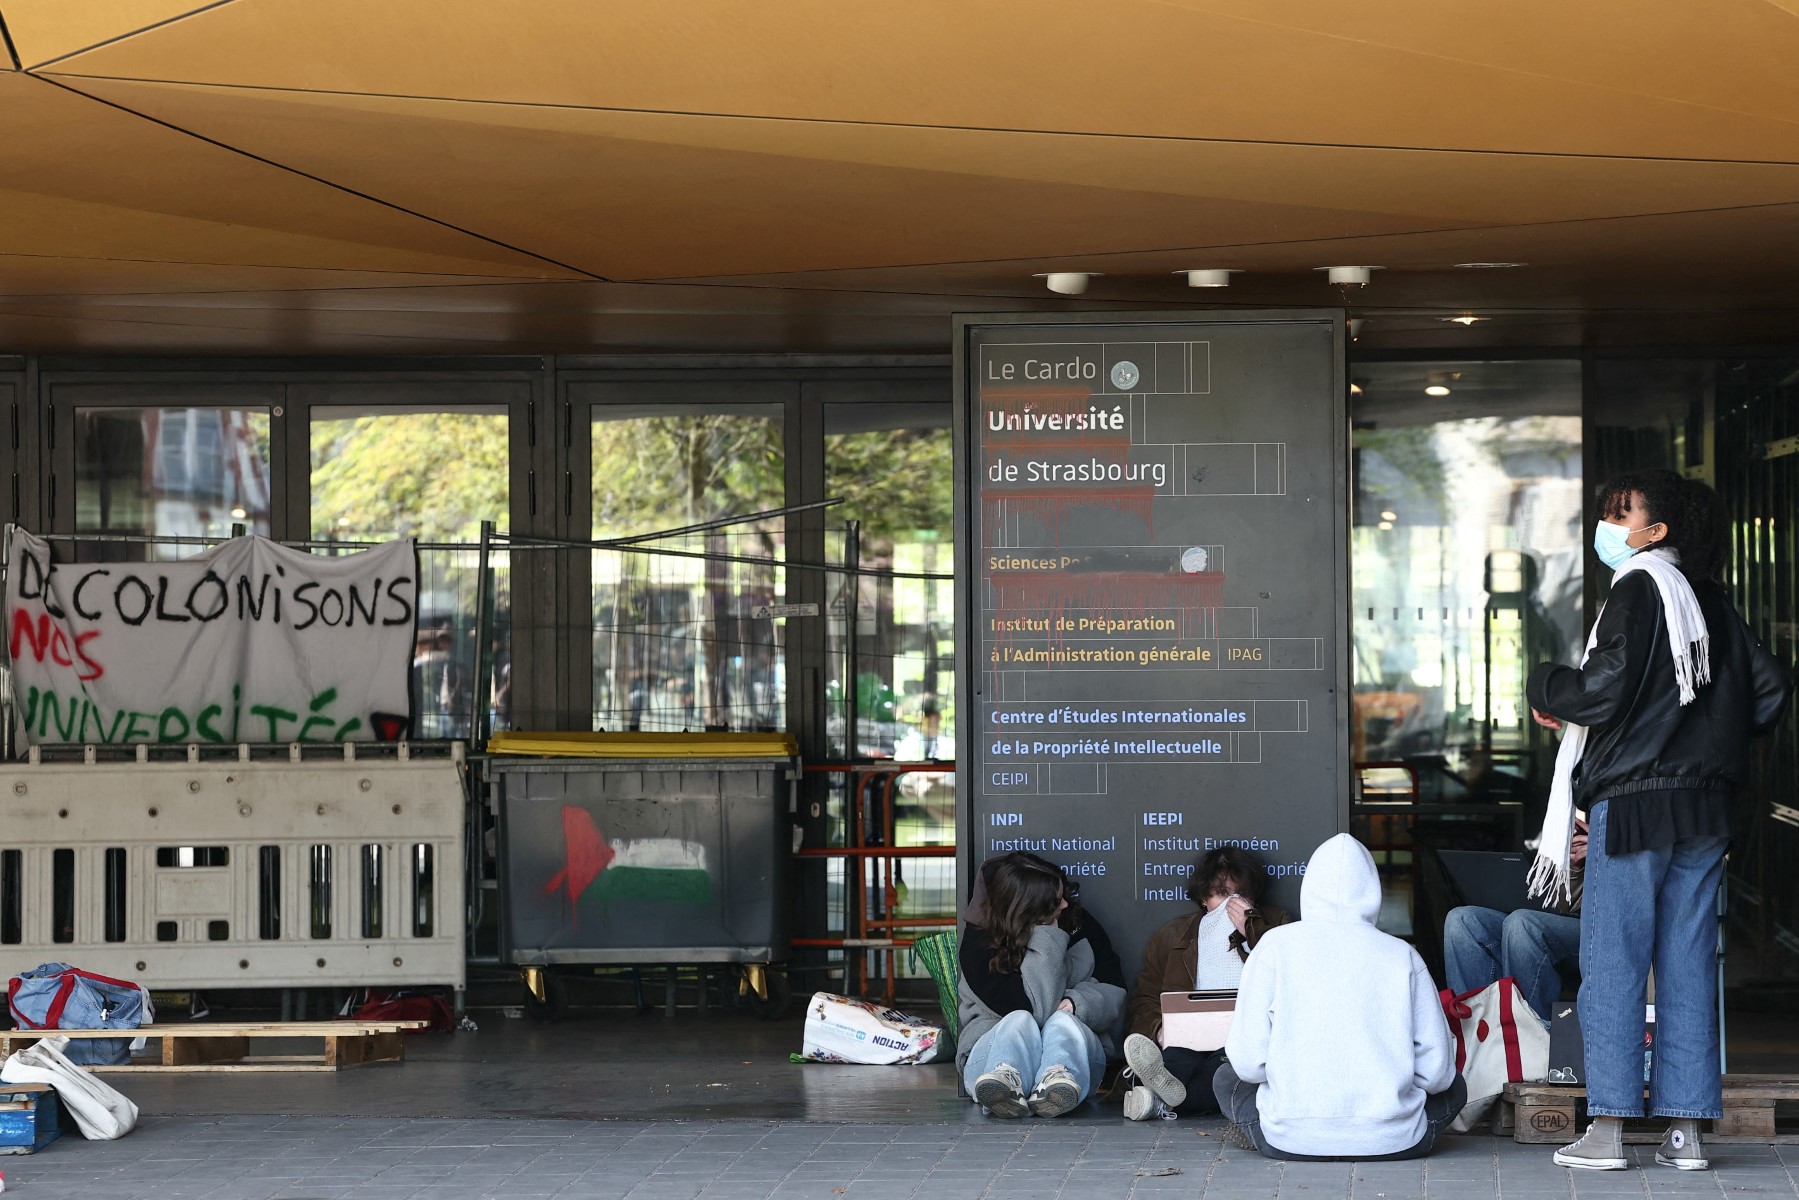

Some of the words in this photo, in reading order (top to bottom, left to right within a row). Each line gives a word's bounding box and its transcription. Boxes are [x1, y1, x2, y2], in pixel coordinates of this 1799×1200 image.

[988, 360, 1015, 380] Le
[1024, 356, 1096, 380] Cardo
[989, 405, 1125, 431] Université
[988, 459, 1019, 482] de
[1027, 458, 1166, 487] Strasbourg
[990, 555, 1057, 570] Sciences
[991, 616, 1050, 631] Institut
[1055, 616, 1075, 631] de
[1079, 616, 1175, 635] Préparation
[10, 607, 104, 681] NOS
[1004, 647, 1135, 662] l'Administration
[1139, 646, 1211, 666] générale
[1228, 648, 1262, 661] IPAG
[991, 711, 1044, 724] Centre
[1048, 706, 1118, 724] d'Études
[1122, 708, 1247, 723] Internationales
[991, 740, 1012, 755] de
[1015, 740, 1029, 755] la
[1033, 739, 1110, 758] Propriété
[1114, 739, 1222, 754] Intellectuelle
[992, 772, 1028, 786] CEIPI
[991, 813, 1023, 826] INPI
[1143, 812, 1183, 826] IEEPI
[991, 836, 1047, 851] Institut
[1052, 835, 1115, 851] National
[1144, 836, 1200, 851] Institut
[1204, 836, 1279, 851] Européen
[872, 1035, 909, 1052] ACTION
[1536, 1116, 1565, 1128] EPAL
